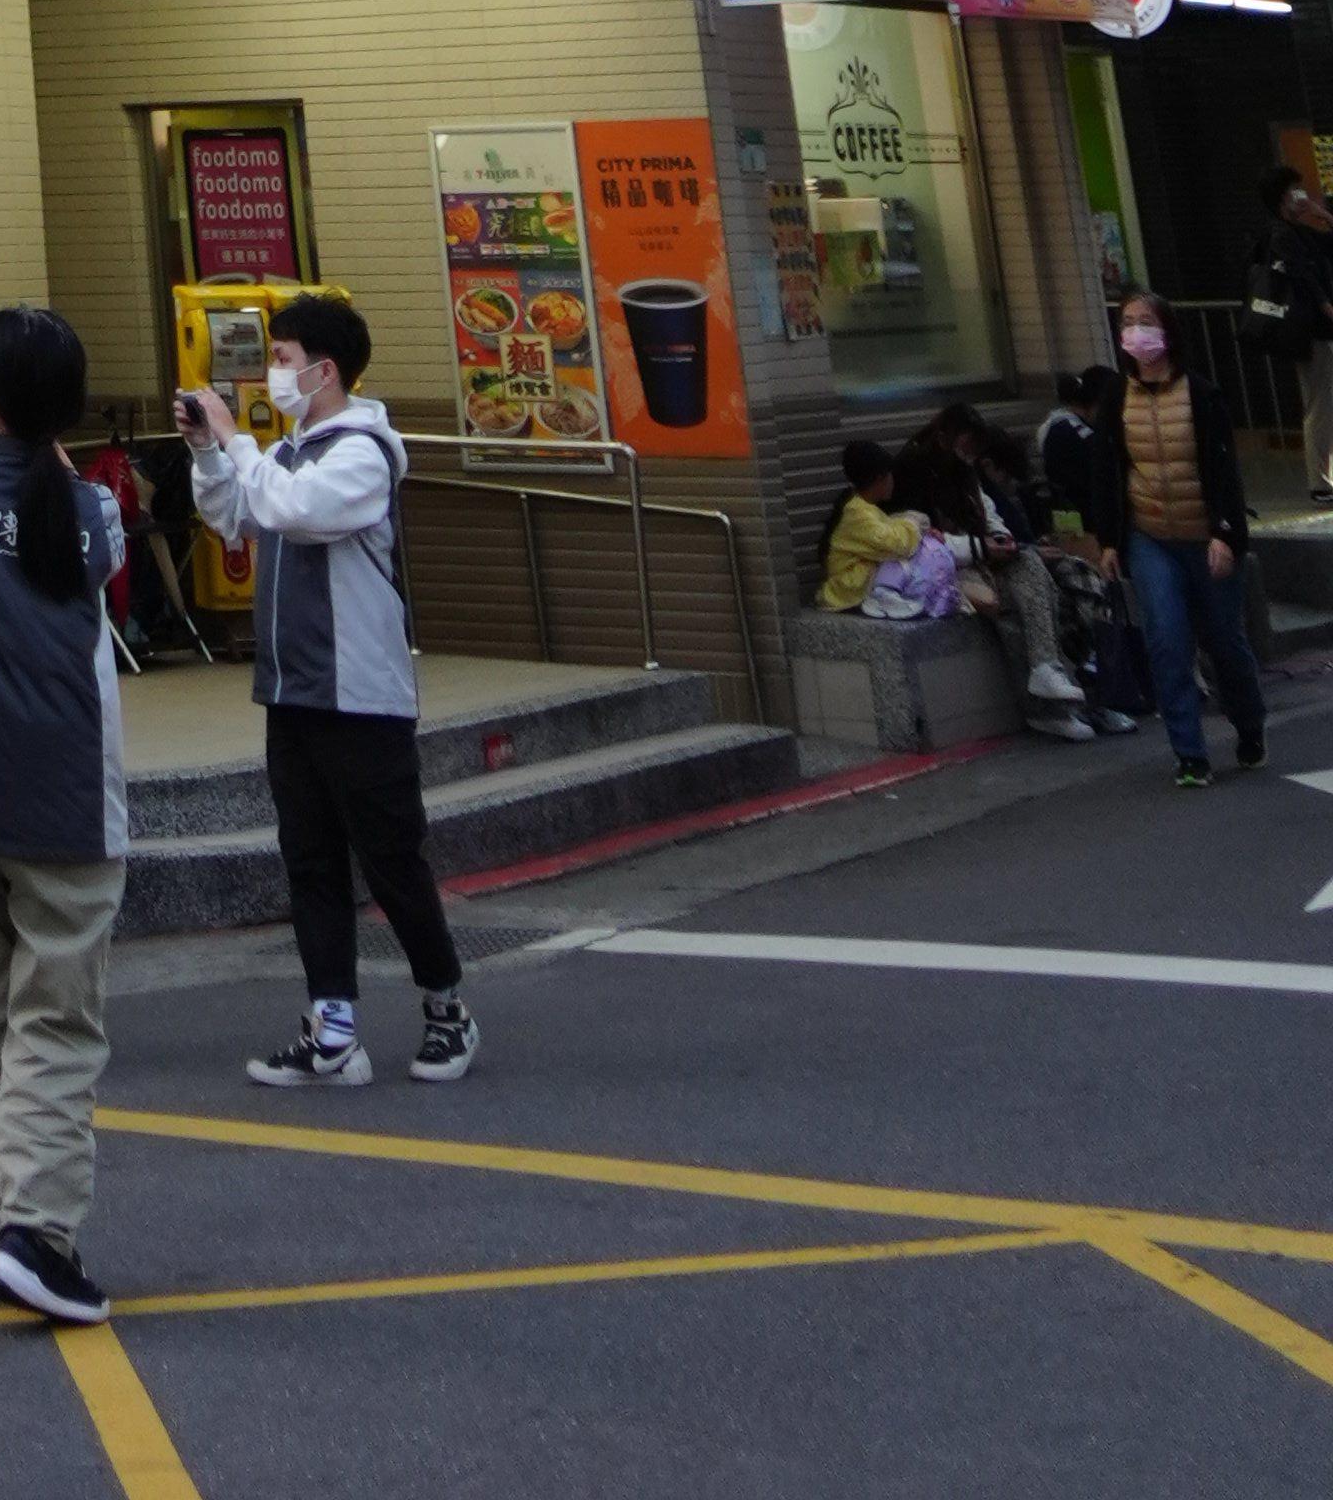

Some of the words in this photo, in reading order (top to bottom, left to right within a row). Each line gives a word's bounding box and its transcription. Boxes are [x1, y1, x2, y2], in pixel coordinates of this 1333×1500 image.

[834, 121, 903, 164] COFFEE
[193, 147, 279, 167] foodomo
[596, 156, 635, 173] CITY
[640, 156, 697, 172] PRIMA
[195, 172, 282, 194] foodomo
[600, 177, 700, 208] 精品咖啡
[197, 198, 285, 220] foodomo
